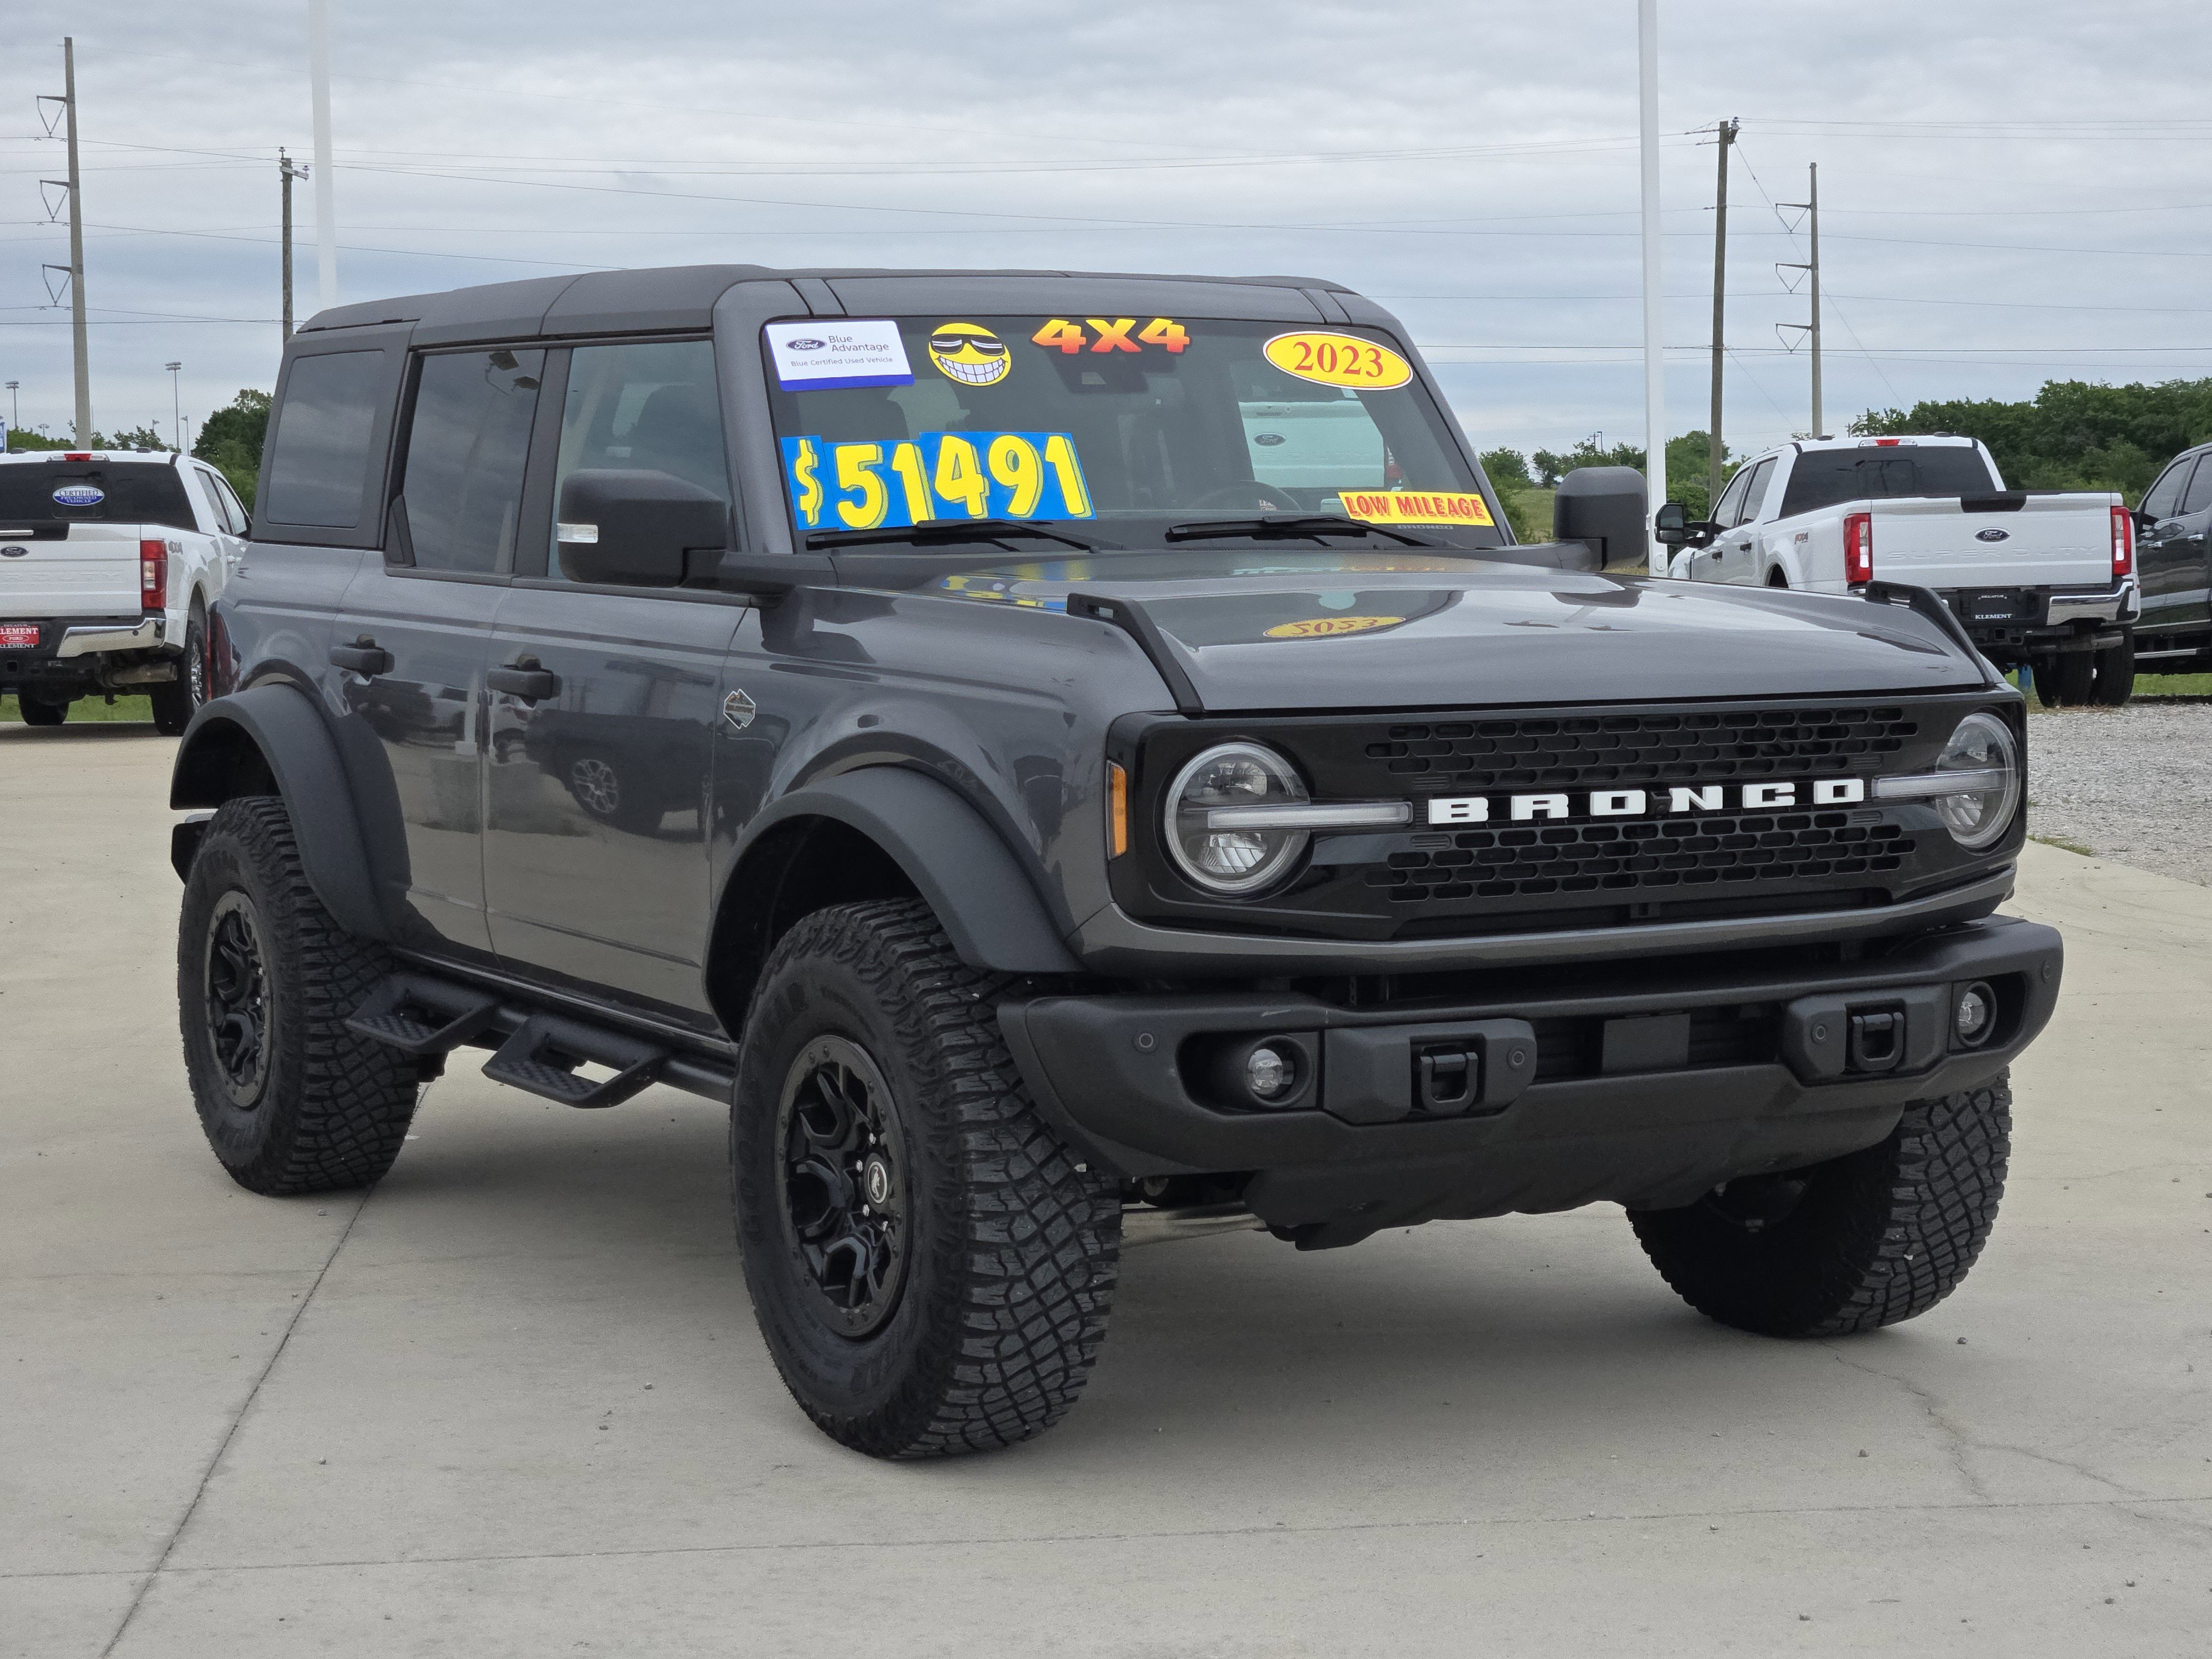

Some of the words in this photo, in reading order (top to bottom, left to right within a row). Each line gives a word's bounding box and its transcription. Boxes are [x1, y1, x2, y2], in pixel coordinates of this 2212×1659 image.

[794, 340, 820, 349] Ford
[831, 343, 890, 352] Advantage
[1031, 318, 1190, 354] 4X4
[1293, 341, 1384, 378] 2023
[794, 435, 1092, 529] $51491
[1344, 495, 1389, 517] LOW
[1395, 495, 1485, 519] MILEAGE
[1983, 530, 2003, 539] Ford
[1887, 548, 2002, 560] SUPER
[2012, 545, 2099, 556] DUTY
[1428, 778, 1865, 825] BRONCO
